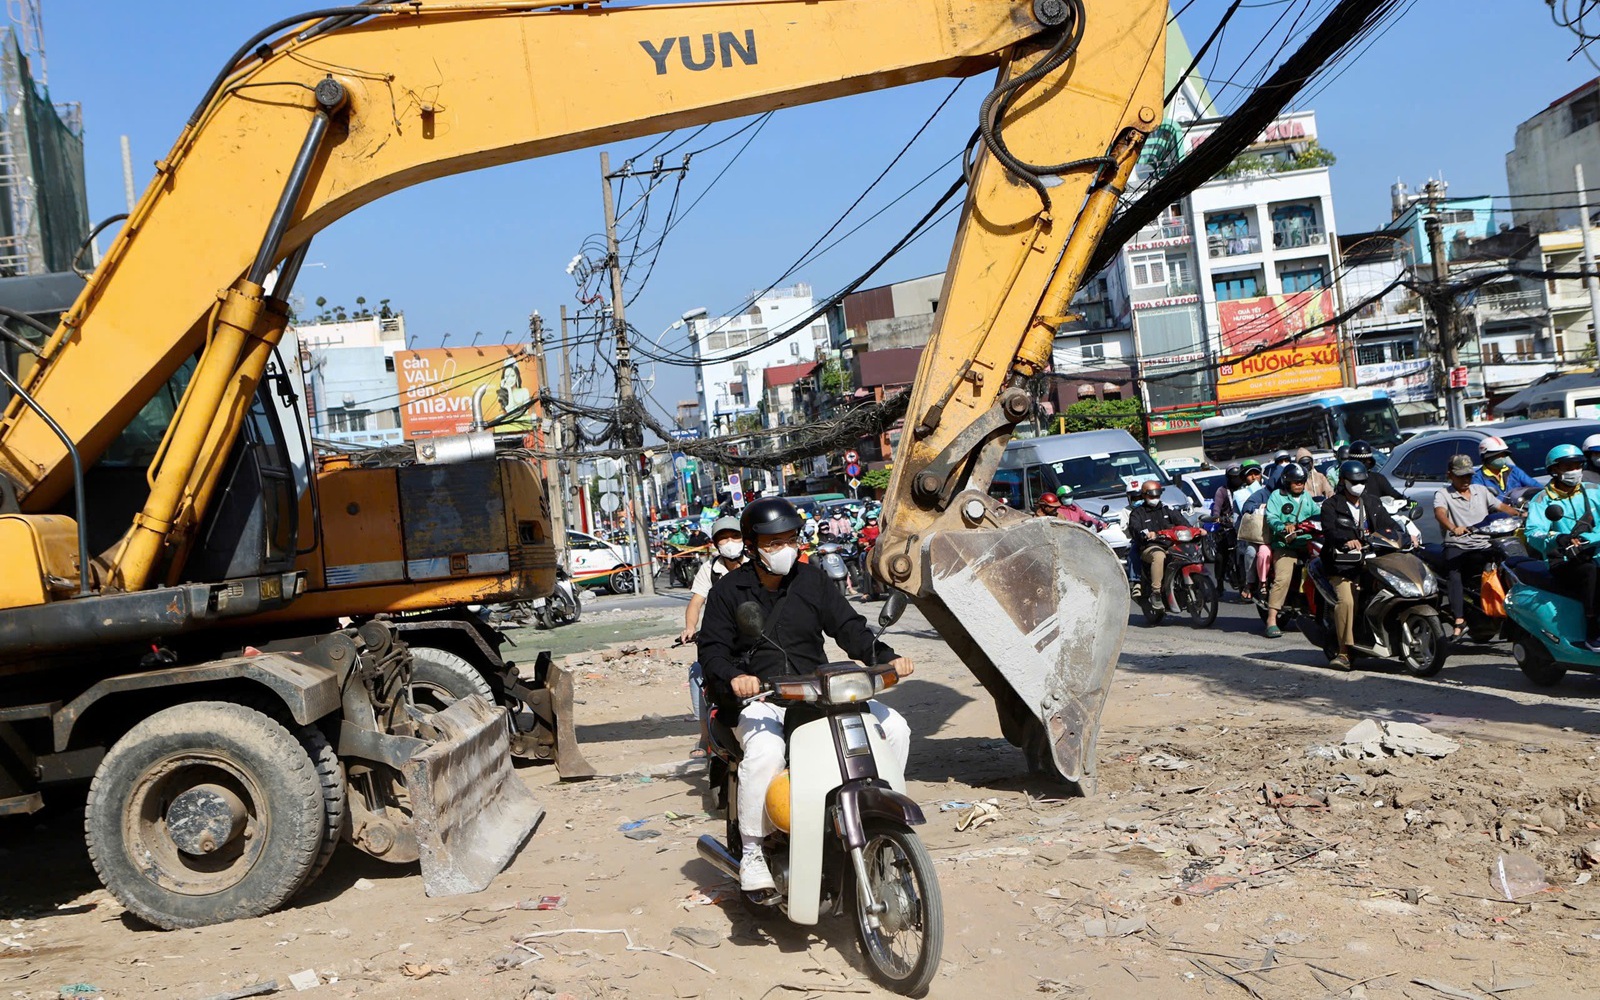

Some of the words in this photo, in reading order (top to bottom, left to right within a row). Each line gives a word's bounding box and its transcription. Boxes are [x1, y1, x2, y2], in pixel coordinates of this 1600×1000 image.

[638, 29, 758, 75] YUN
[1151, 241, 1171, 249] HOA
[1133, 301, 1152, 310] HOA
[1174, 296, 1200, 305] FOOD
[404, 369, 438, 383] VALI
[407, 396, 472, 415] mia.vn
[1170, 419, 1191, 428] HOA
